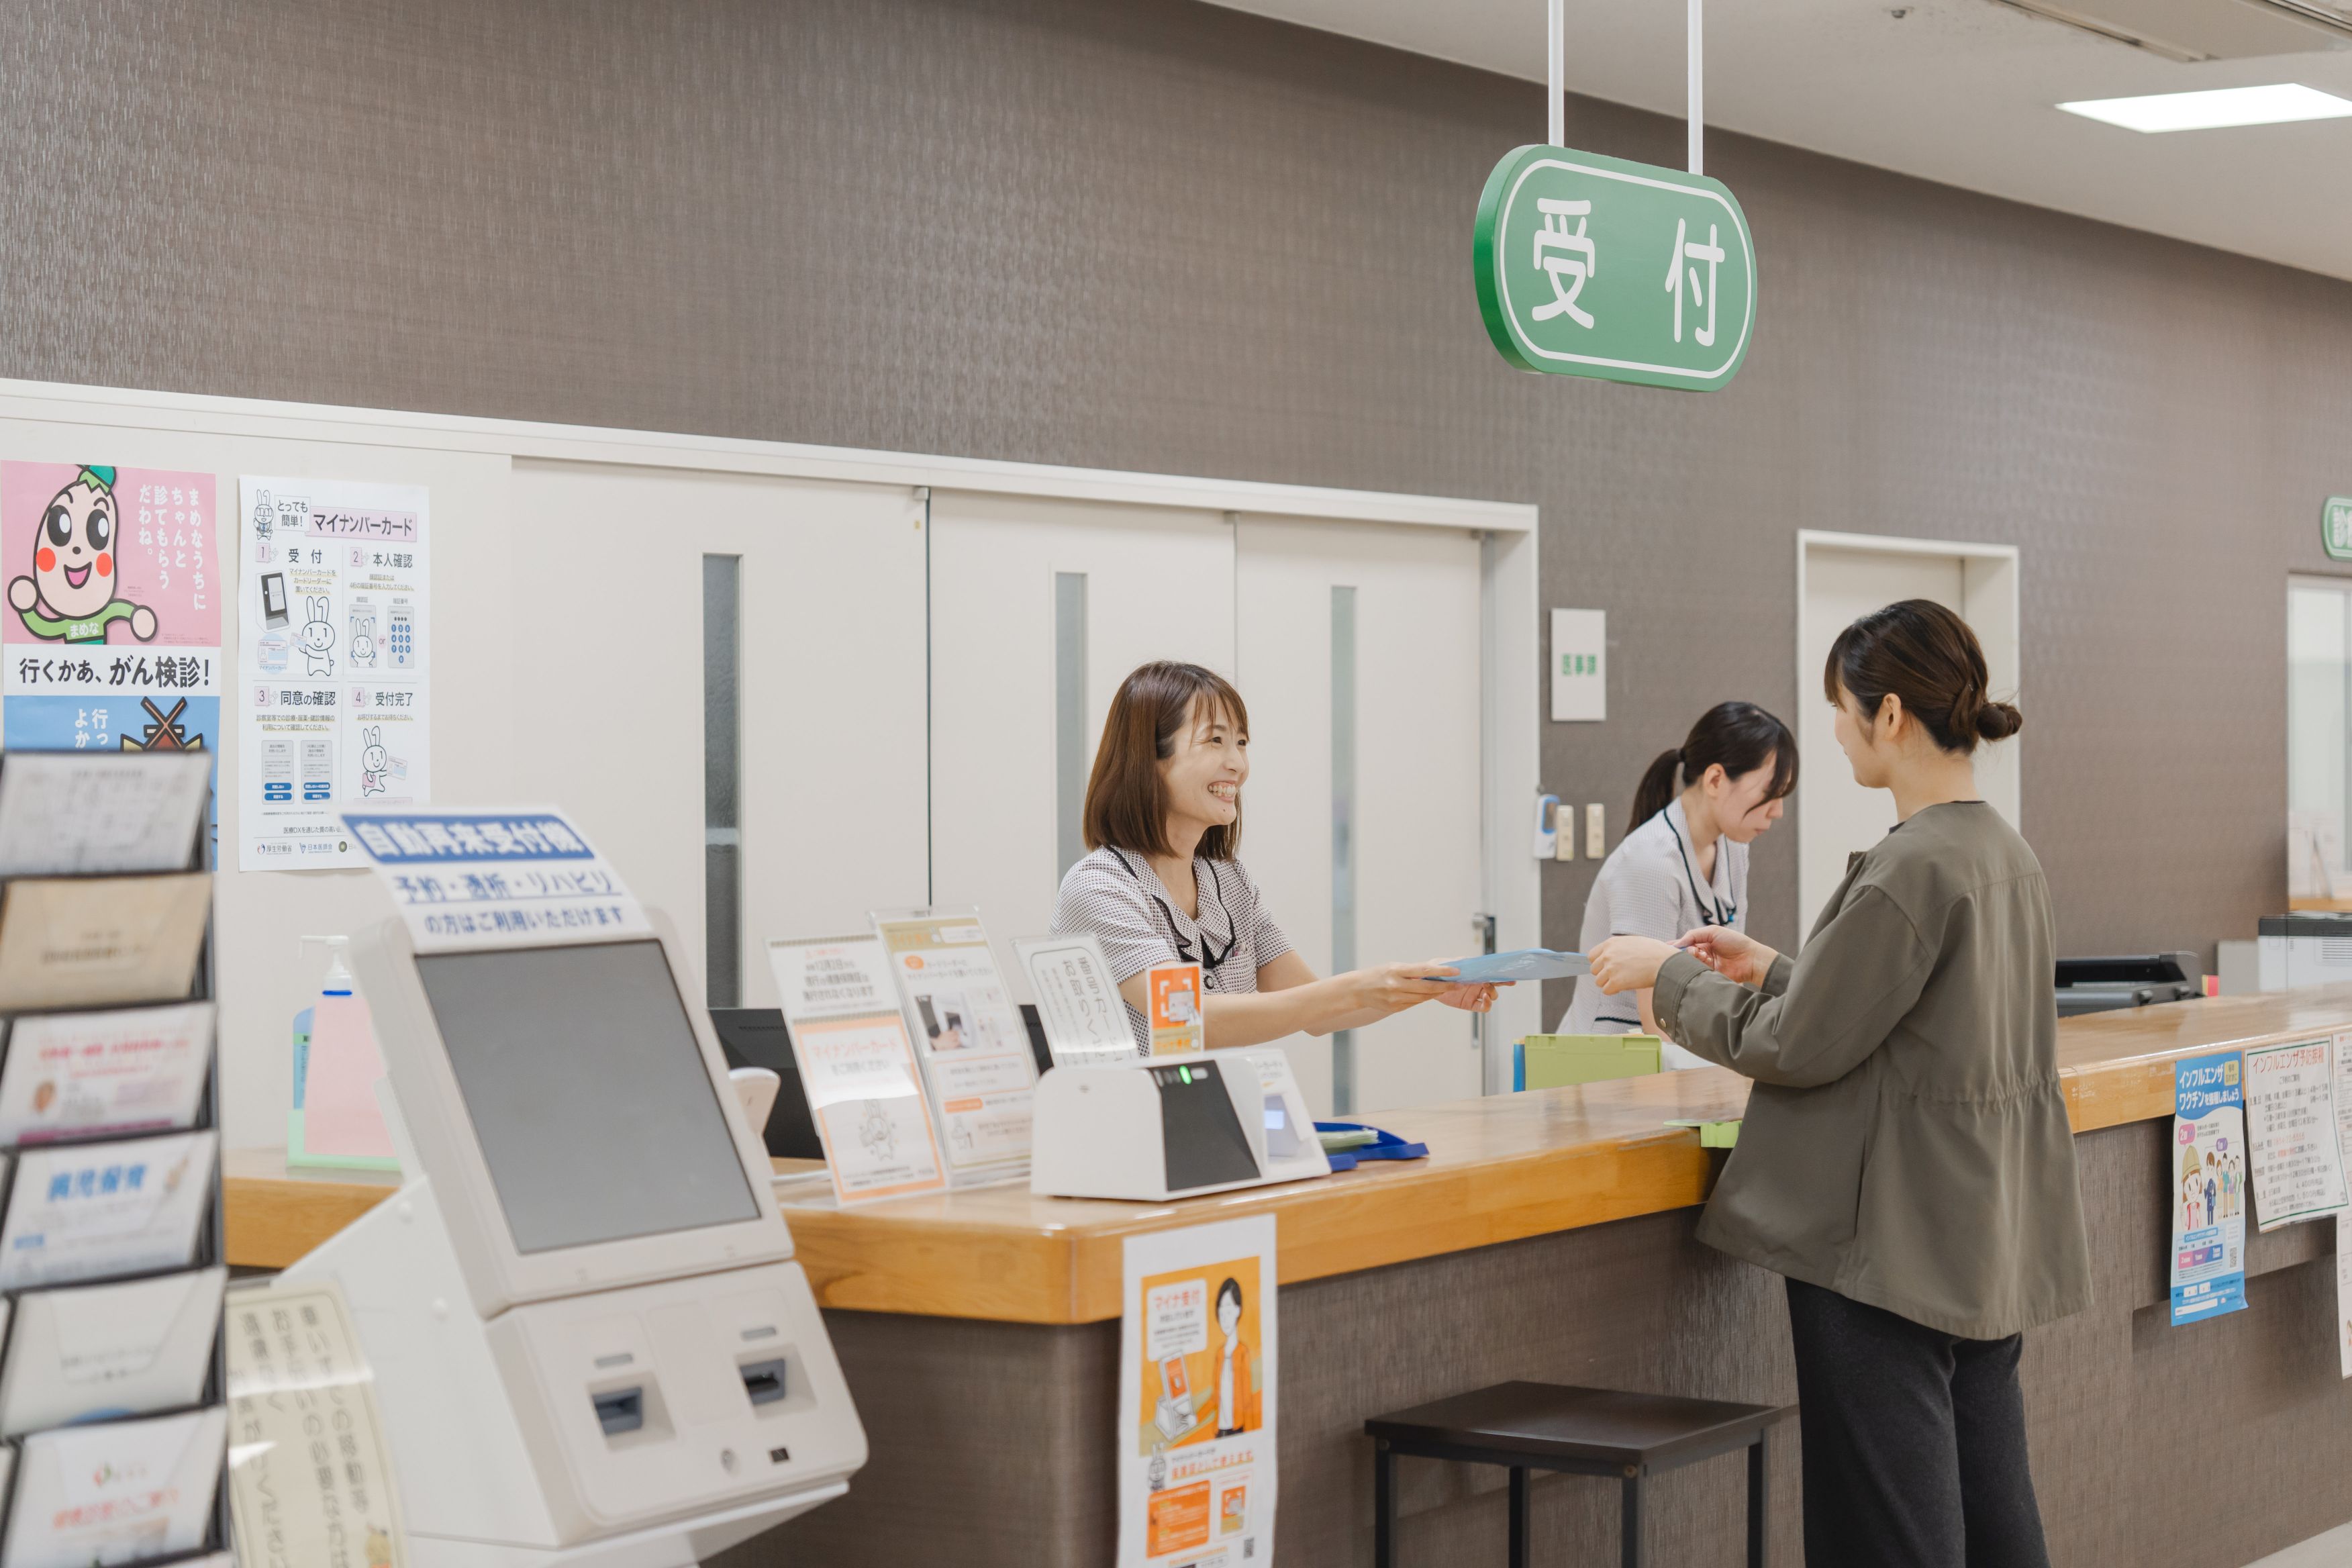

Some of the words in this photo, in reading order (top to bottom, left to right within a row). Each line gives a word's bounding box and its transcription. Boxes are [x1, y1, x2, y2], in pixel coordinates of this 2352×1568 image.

[1532, 197, 1726, 346] 受付
[277, 499, 308, 513] とっても
[138, 485, 153, 555] だわね。
[172, 487, 187, 568] ちゃんと
[281, 514, 303, 527] 簡単!
[313, 513, 412, 536] マイナンバーカード
[154, 485, 169, 589] 診てもらう
[189, 488, 206, 610] まめなうちに
[289, 548, 322, 564] 受付
[353, 550, 358, 562] 2
[373, 552, 413, 568] 本人確認
[70, 622, 99, 638] まめな
[259, 690, 264, 702] 3
[281, 691, 336, 705] 同意の確認
[356, 691, 361, 703] 4
[376, 691, 413, 706] 受付完了
[91, 709, 109, 748] 行っ
[354, 821, 585, 856] 自動再来受付機
[424, 906, 624, 934] の方はご利用いただけます
[2179, 1064, 2224, 1089] インフルエンザ
